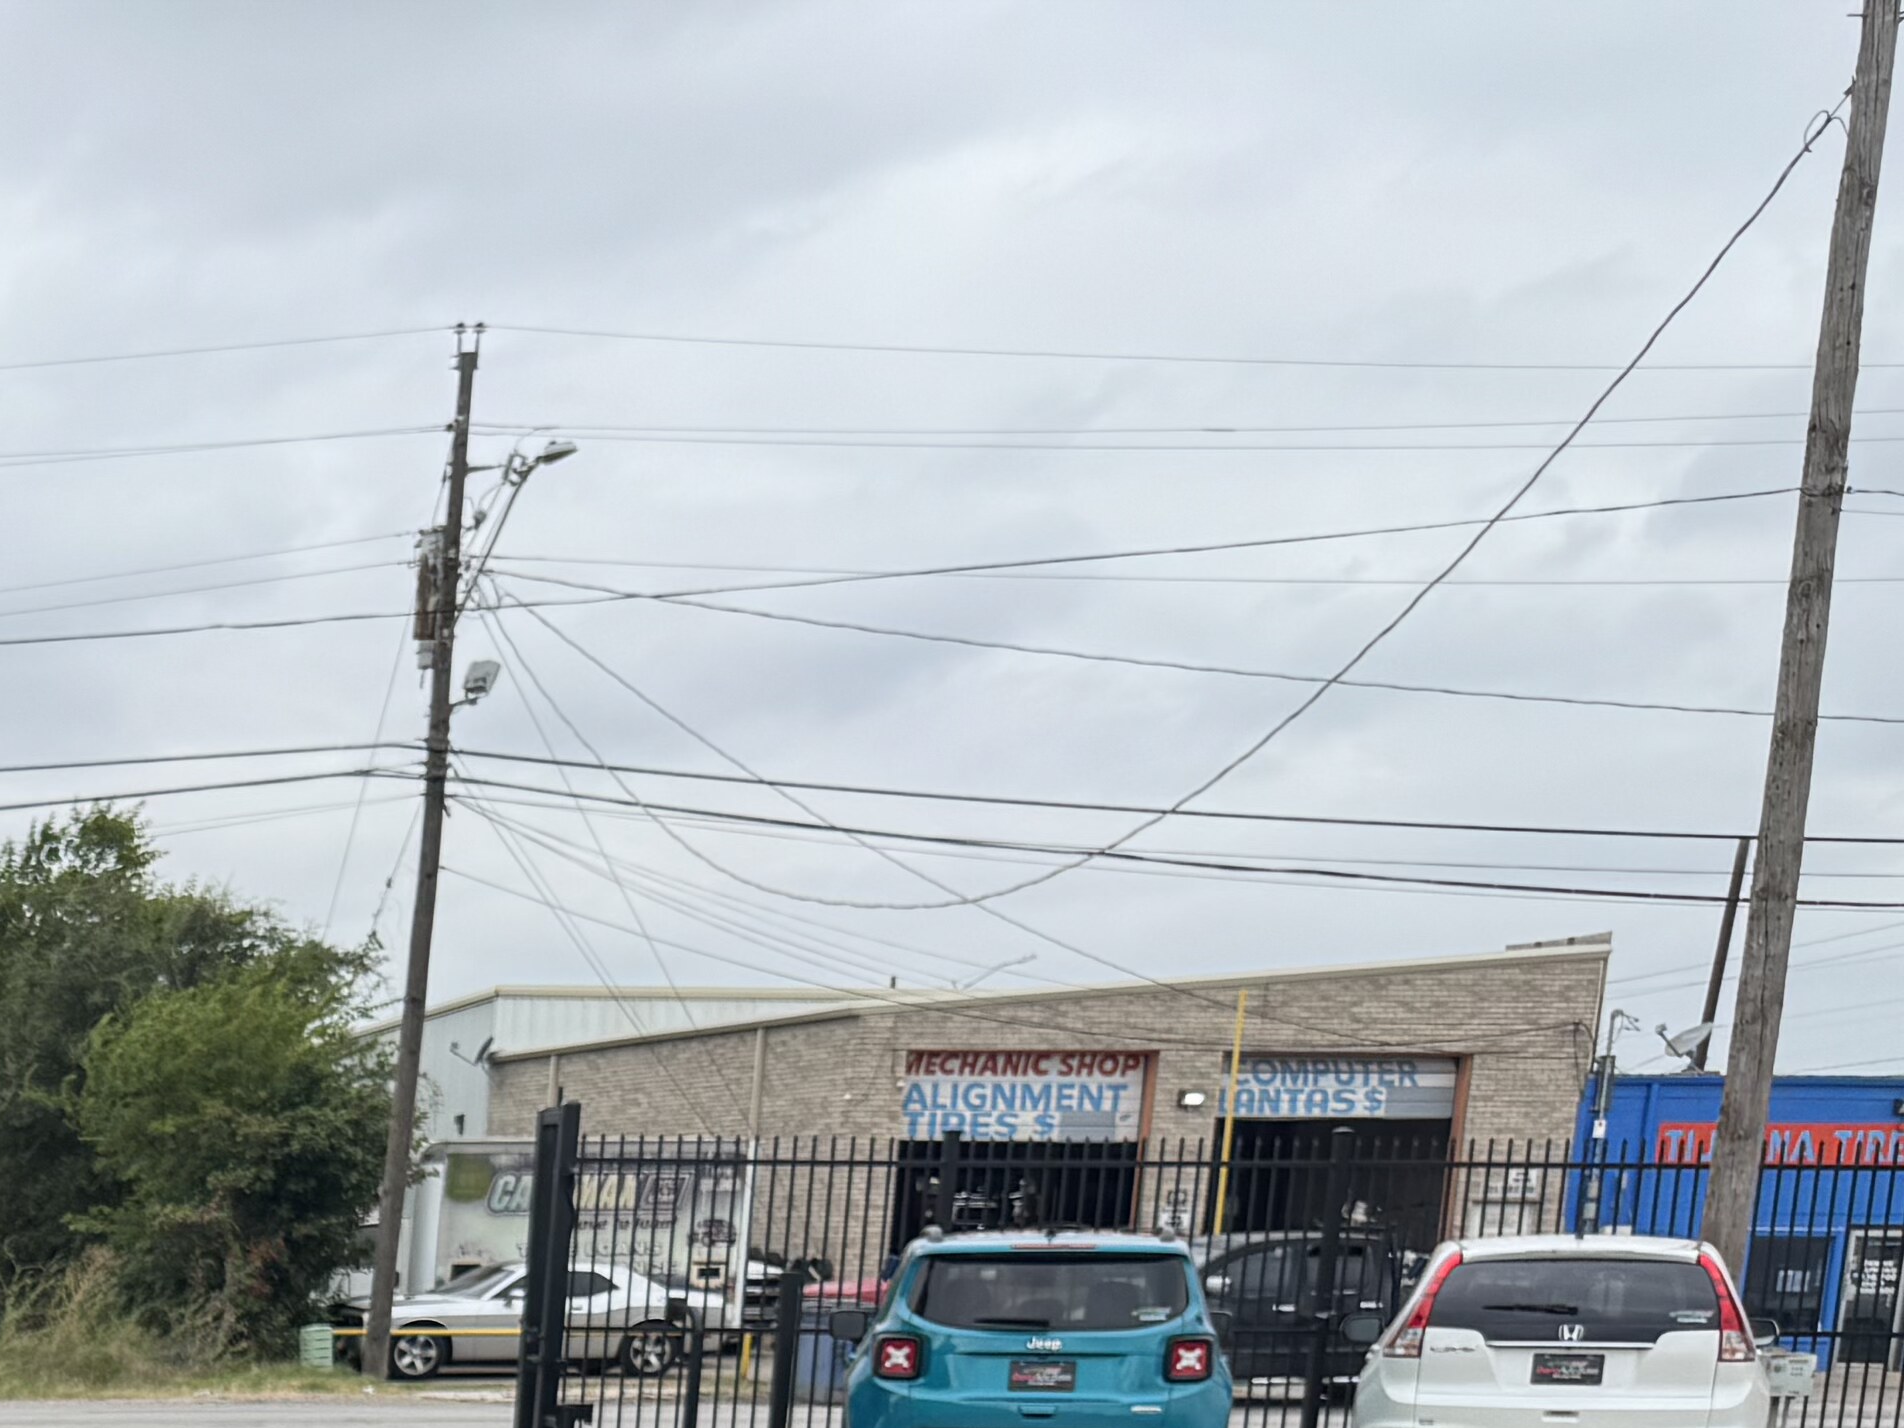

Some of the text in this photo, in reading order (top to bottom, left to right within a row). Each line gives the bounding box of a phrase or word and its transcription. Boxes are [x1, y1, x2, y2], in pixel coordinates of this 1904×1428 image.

[906, 1051, 1141, 1077] MECHANIC SHOP
[902, 1083, 1128, 1113] ALIGNMENT
[1026, 1336, 1063, 1351] Jeep
